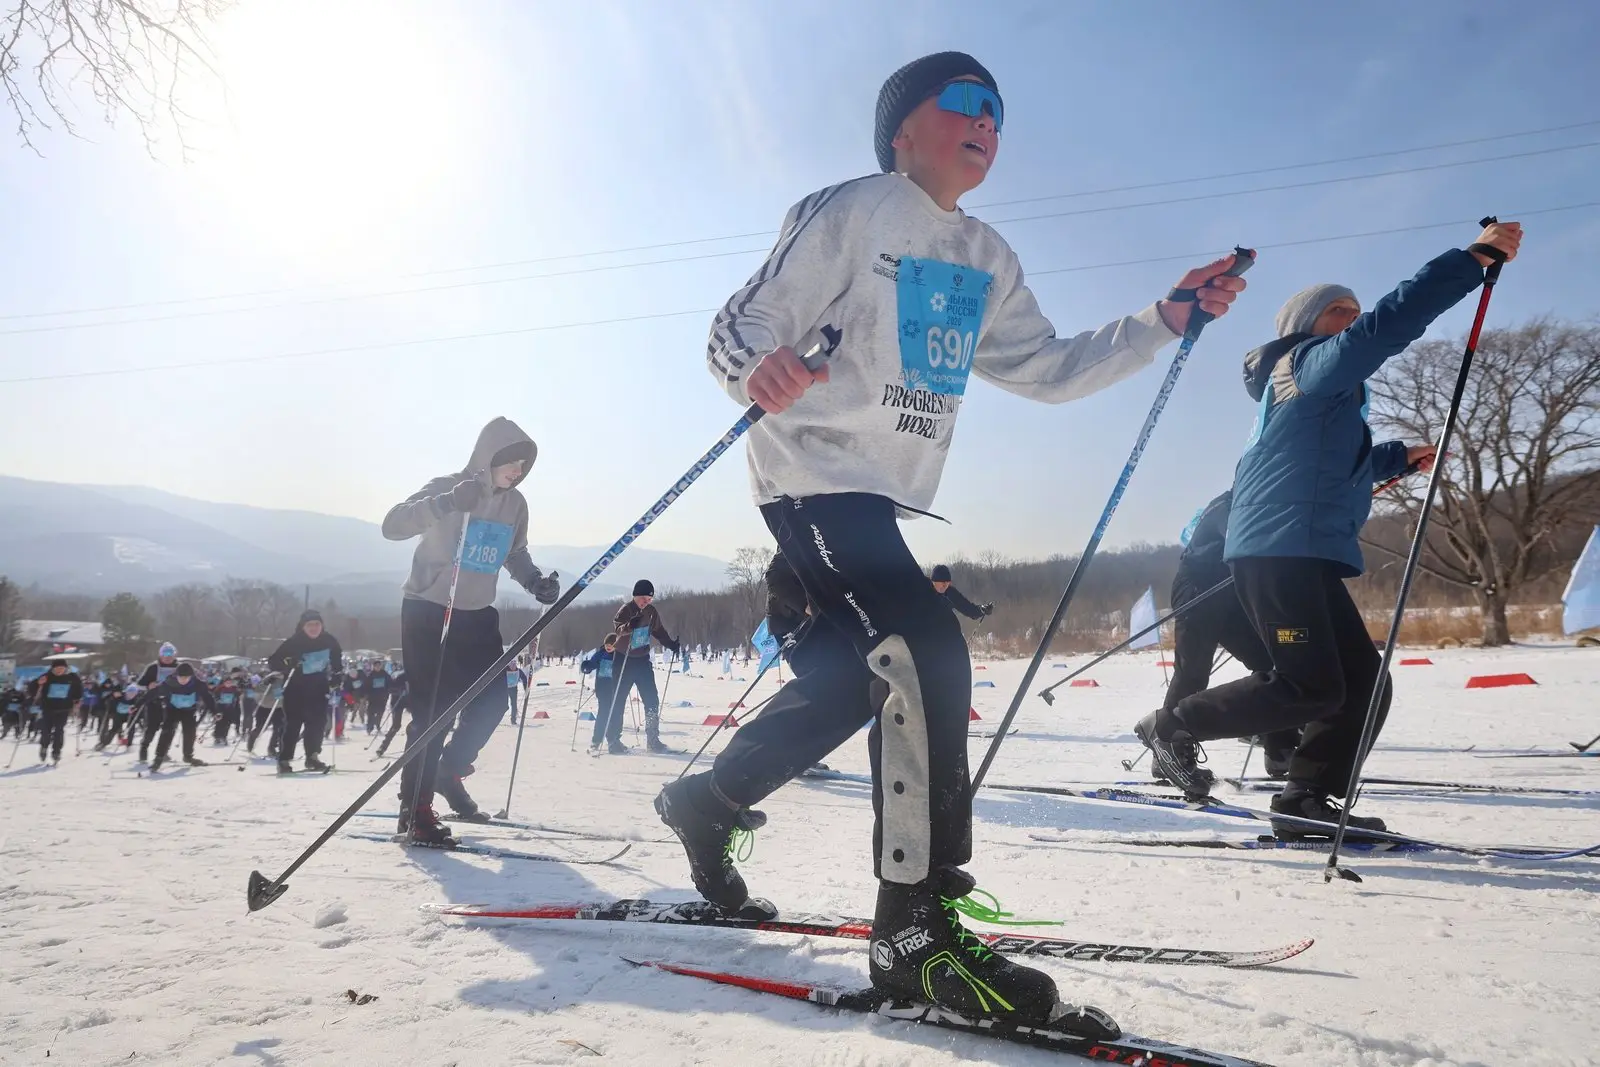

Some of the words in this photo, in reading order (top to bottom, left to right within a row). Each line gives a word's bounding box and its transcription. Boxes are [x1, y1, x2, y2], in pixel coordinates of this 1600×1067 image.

[927, 326, 974, 371] 690
[1115, 794, 1155, 805] NORDWAY
[895, 929, 934, 956] TREK
